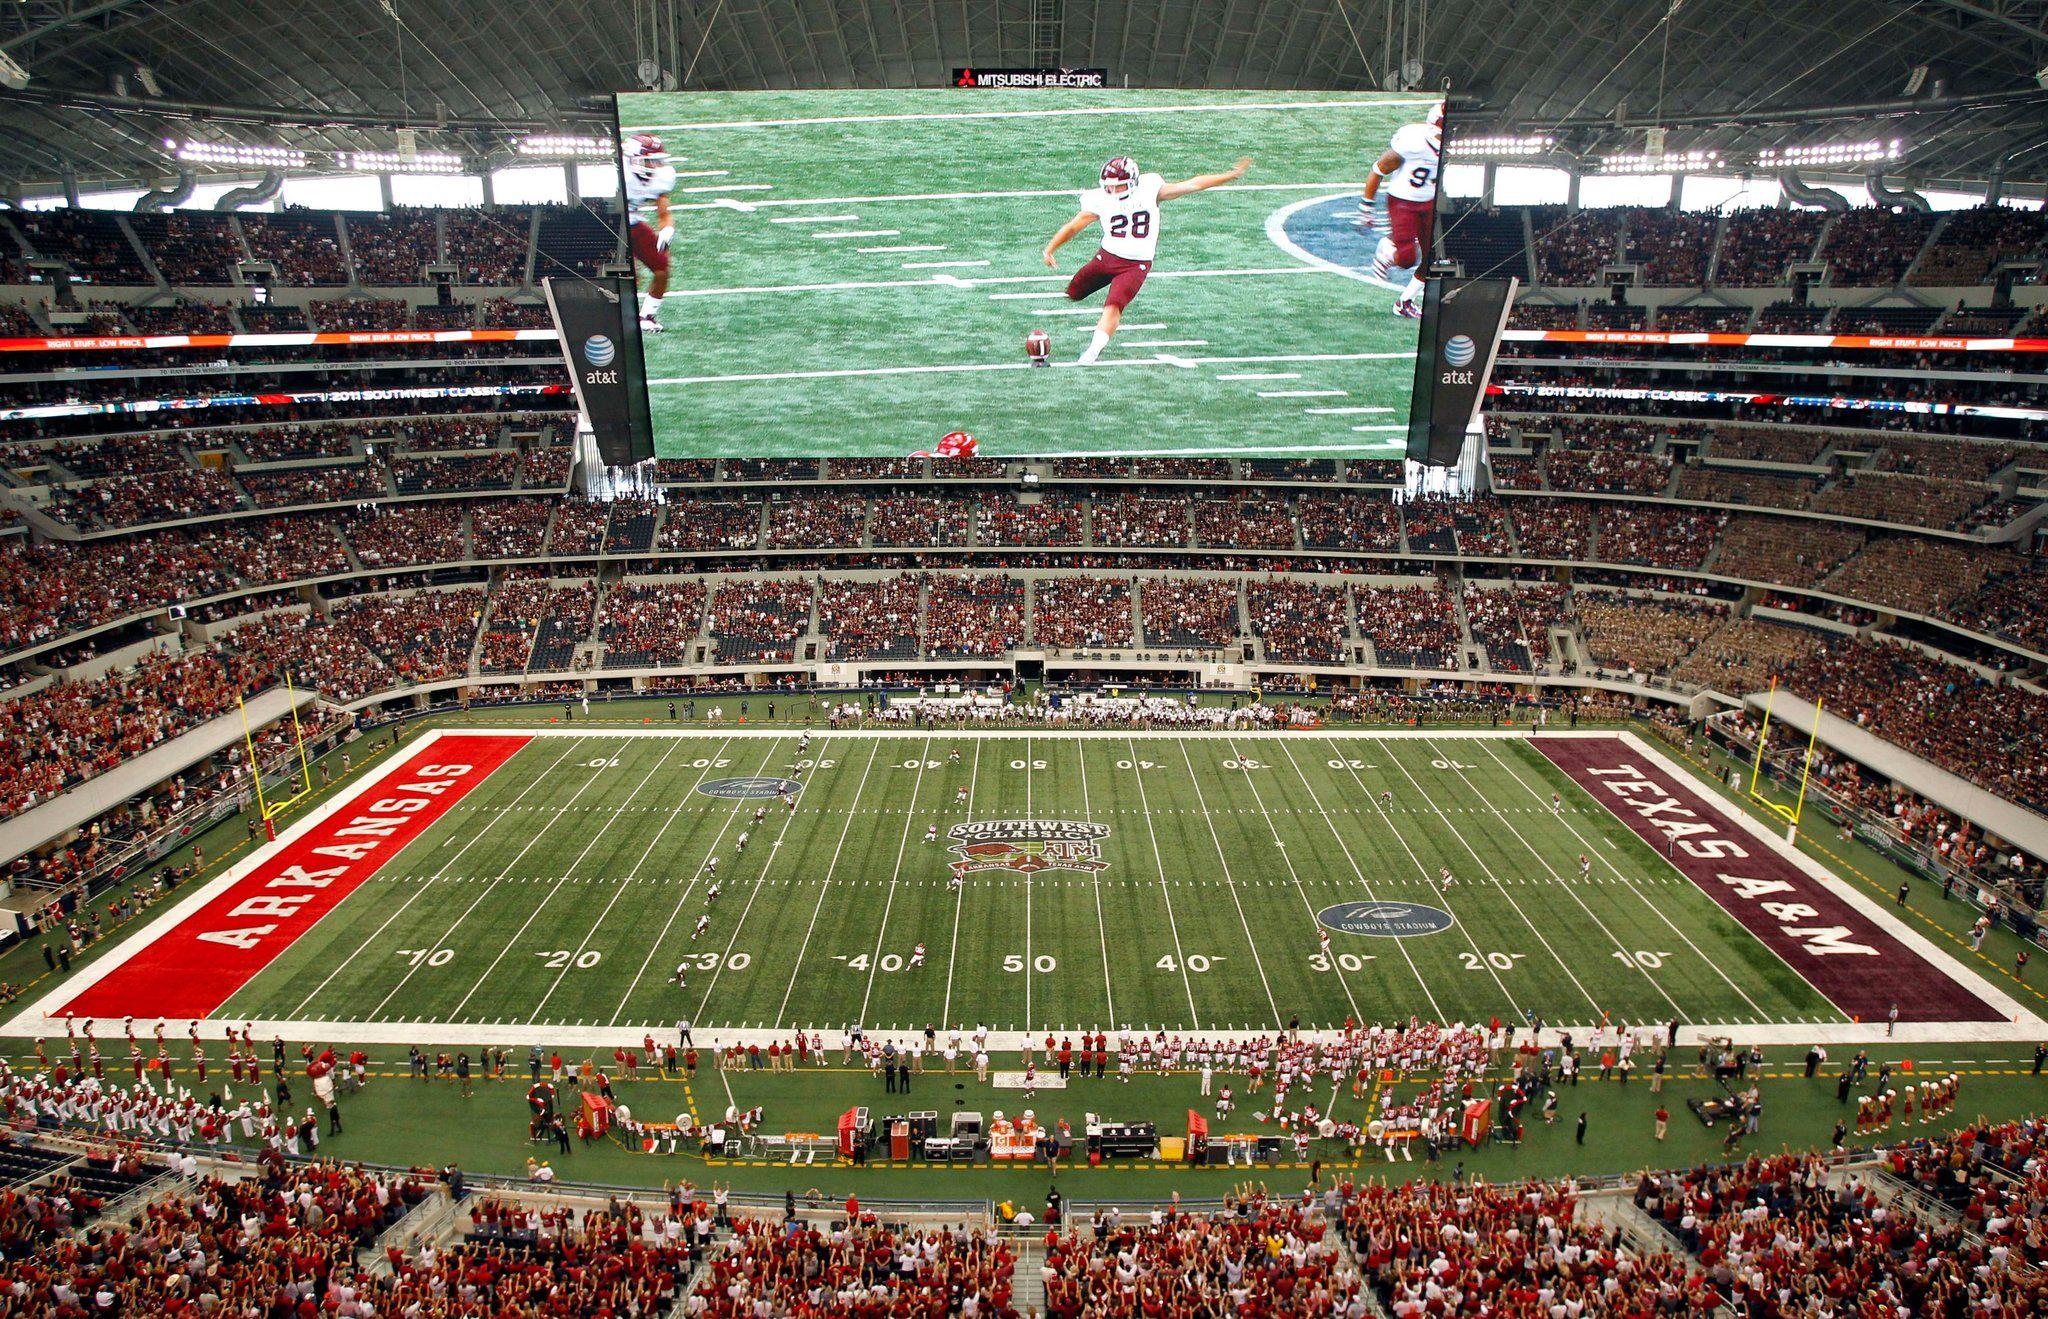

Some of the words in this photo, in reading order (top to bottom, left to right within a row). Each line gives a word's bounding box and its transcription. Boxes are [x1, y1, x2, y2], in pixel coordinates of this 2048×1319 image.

[978, 74, 1043, 86] MITSUBISHI
[1045, 74, 1102, 86] ELECTRIC
[1109, 210, 1150, 238] 28
[47, 340, 71, 348] RIGHT
[1869, 339, 1892, 347] RIGHT
[586, 369, 618, 384] at&t
[1441, 370, 1474, 385] at&t
[332, 391, 360, 402] 2011
[362, 388, 446, 401] SOUTHWEST
[448, 386, 502, 398] CLASSIC
[1538, 387, 1565, 397] 2011
[1566, 387, 1646, 400] SOUTHWEST
[1650, 390, 1709, 402] CLASSIC
[953, 820, 1107, 836] SOUTHWEST
[974, 830, 1082, 840] CLASSIC
[196, 763, 473, 949] ARKANSAS
[1586, 764, 1750, 858] TEXAS
[1716, 873, 1881, 957] A&M
[968, 862, 1010, 871] ARKANSAS
[1394, 922, 1438, 930] STADIUM
[408, 949, 455, 967] 10
[544, 950, 602, 969] 20
[696, 952, 752, 971] 30
[847, 954, 903, 972] 40
[1002, 954, 1057, 972] 50
[1155, 954, 1211, 972] 40
[1308, 953, 1362, 972] 30
[1458, 951, 1514, 970] 20
[1612, 950, 1663, 969] 10
